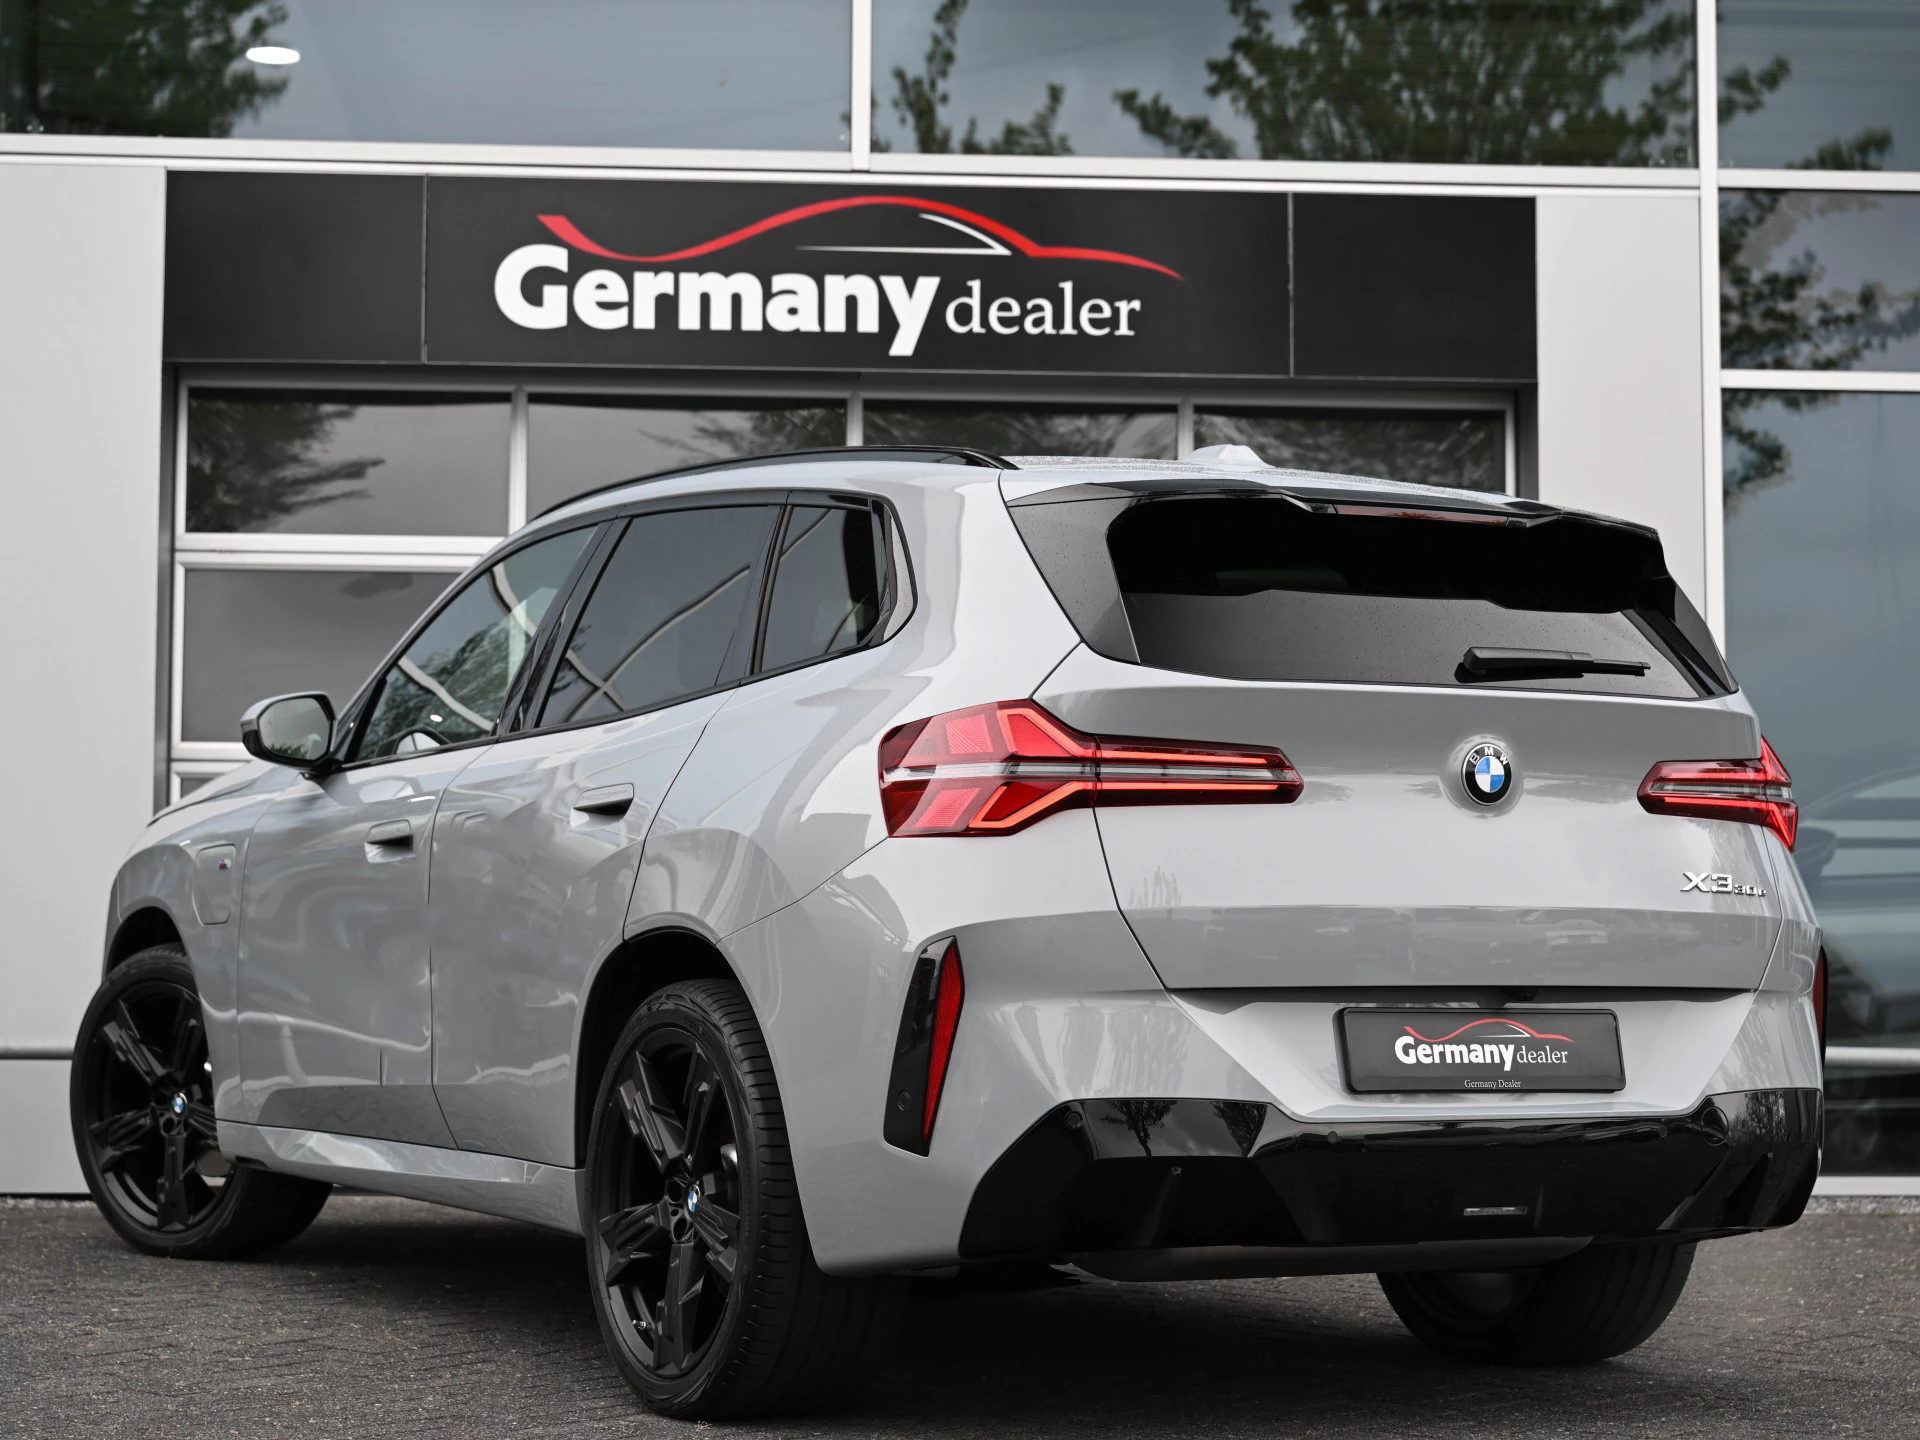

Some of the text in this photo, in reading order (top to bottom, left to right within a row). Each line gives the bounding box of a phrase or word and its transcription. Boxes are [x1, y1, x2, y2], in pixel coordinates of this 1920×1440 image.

[494, 244, 1142, 356] Germany dealer
[1469, 746, 1509, 766] BMW
[1395, 1035, 1568, 1071] Germany dealer
[1464, 1079, 1522, 1090] Germany Dealer
